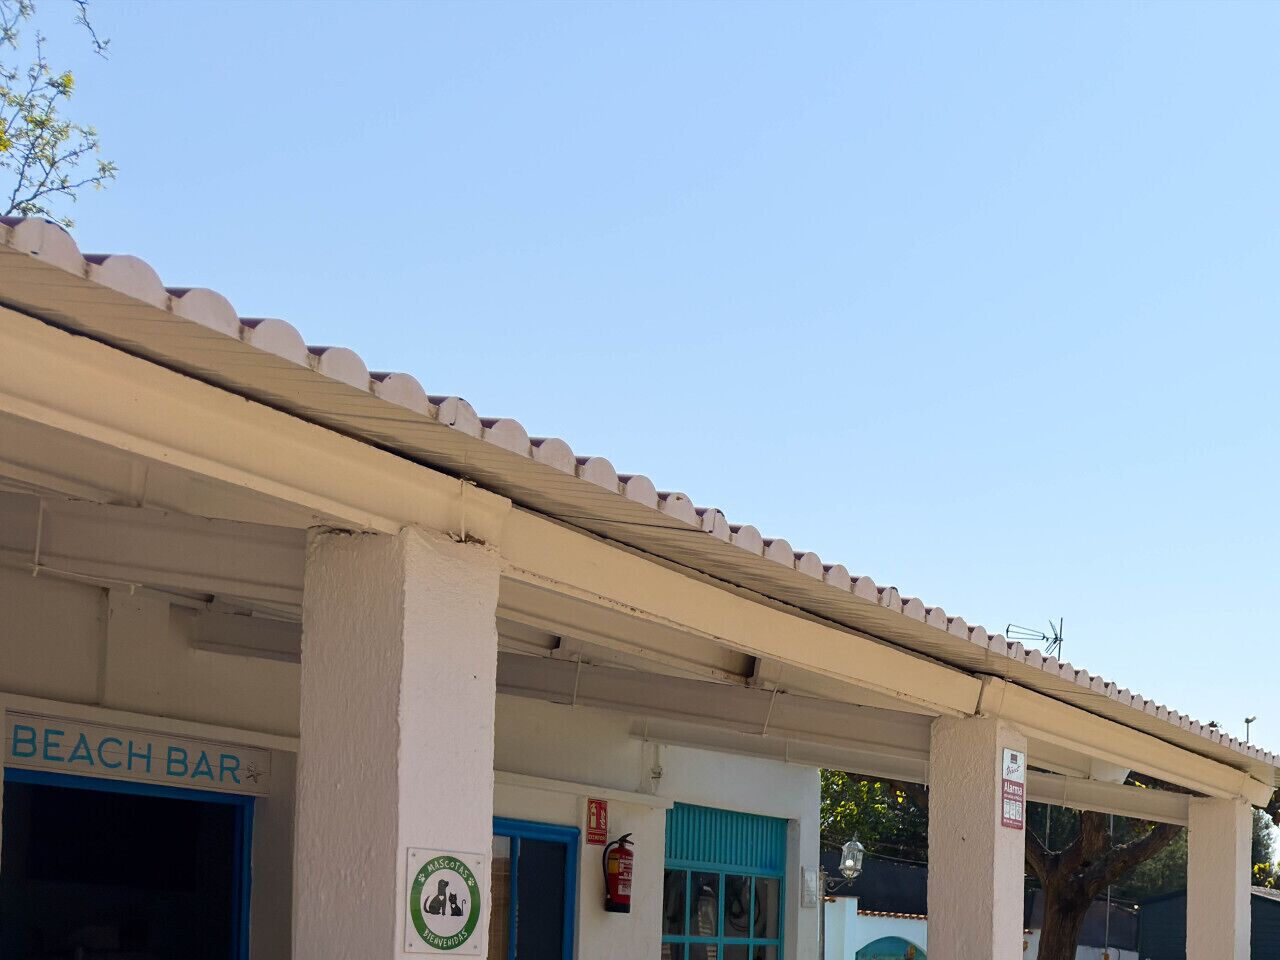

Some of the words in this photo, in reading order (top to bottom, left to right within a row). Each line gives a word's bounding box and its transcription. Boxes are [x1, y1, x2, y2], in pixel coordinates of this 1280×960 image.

[12, 724, 152, 774] BEACH
[166, 746, 241, 785] BAR
[1004, 781, 1023, 795] Alarma
[427, 859, 469, 877] MASCOTAS
[423, 929, 468, 947] BIENVENIDAS
